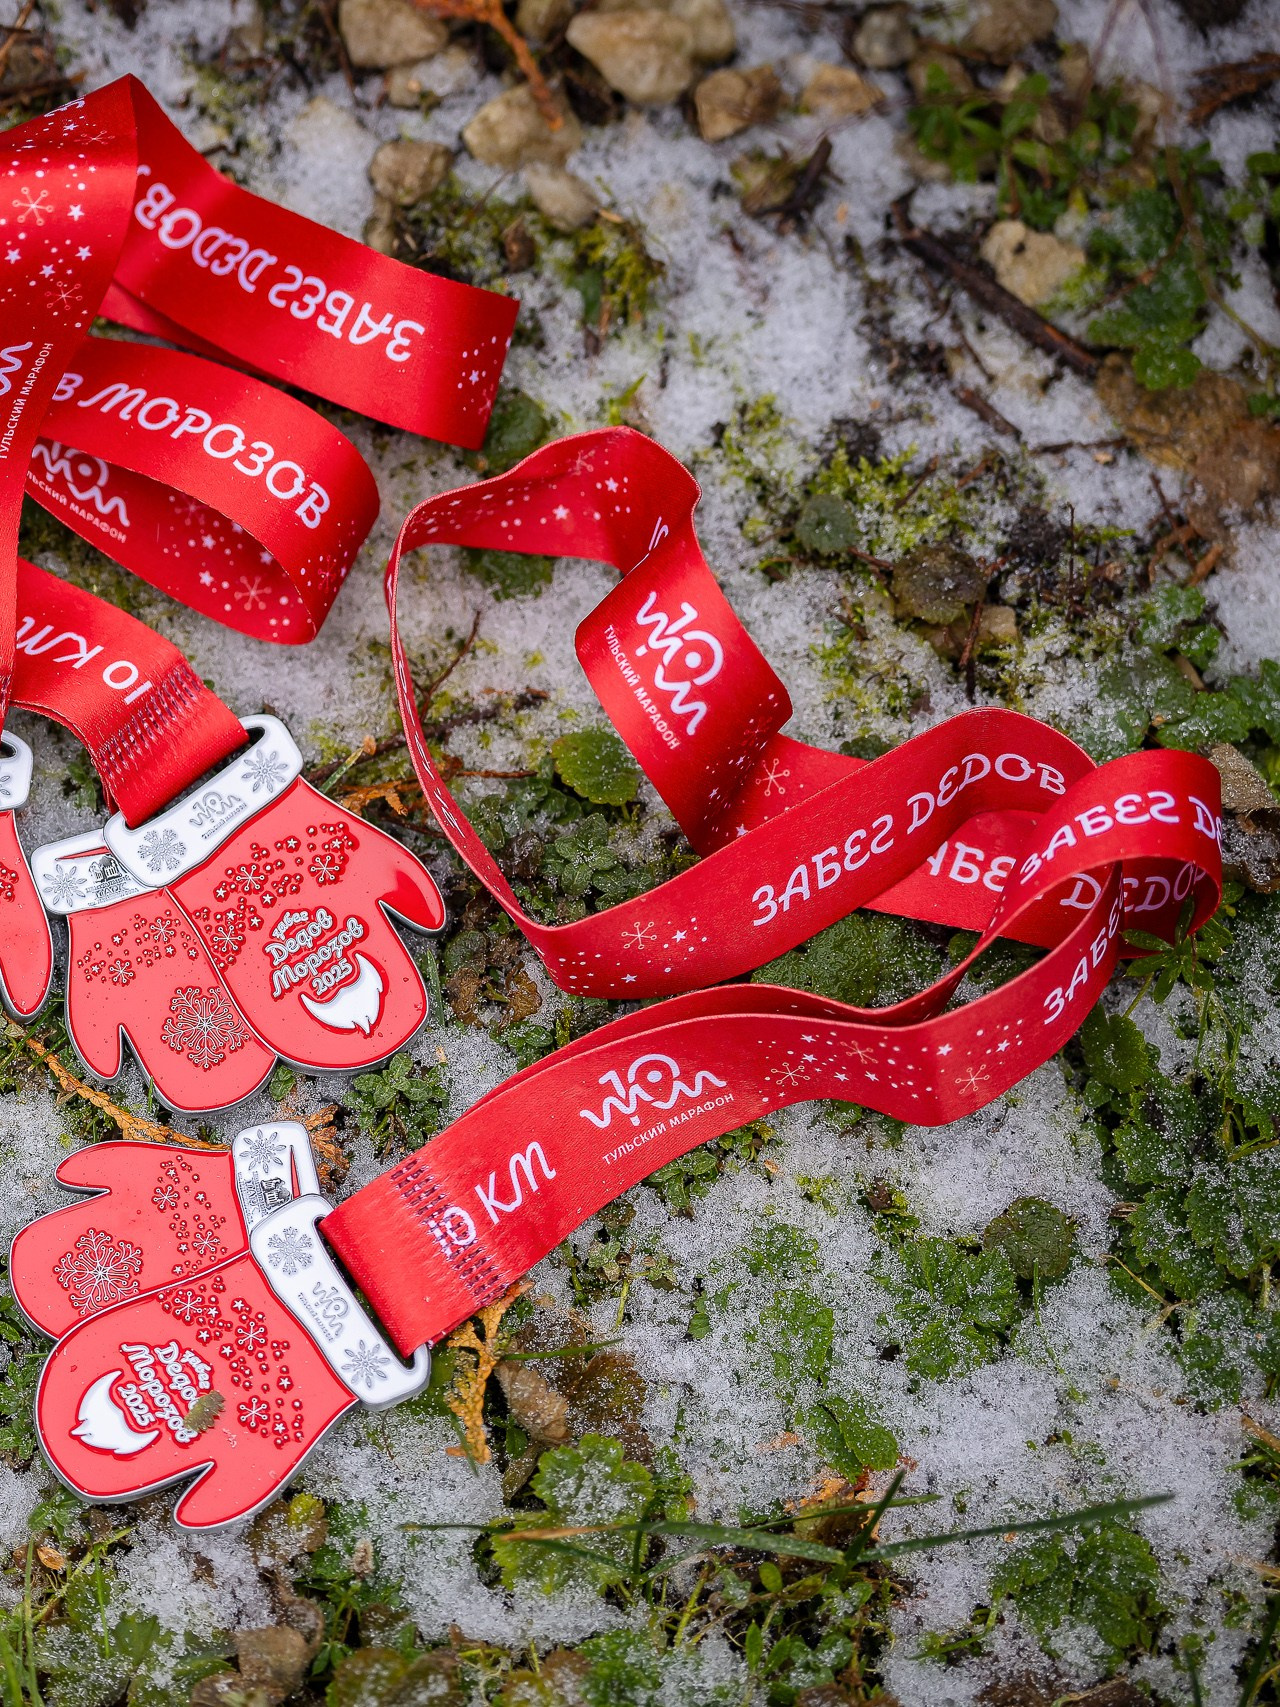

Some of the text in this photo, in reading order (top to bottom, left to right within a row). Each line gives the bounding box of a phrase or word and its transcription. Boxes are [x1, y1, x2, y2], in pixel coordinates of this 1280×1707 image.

[20, 343, 54, 394] МАРАФОН
[78, 383, 330, 529] МОРОЗОВ
[26, 470, 127, 543] ЛЬСКИЙ МАРАФОН
[102, 661, 153, 705] 10
[604, 624, 680, 749] ТУЛЬСКИЙ МАРАФОН
[264, 908, 333, 966] Дедов
[272, 917, 365, 998] Морозов
[311, 957, 353, 996] 2025
[602, 1093, 735, 1165] ТУЛЬСКИЙ МАРАФОН
[117, 1383, 156, 1427] 2025
